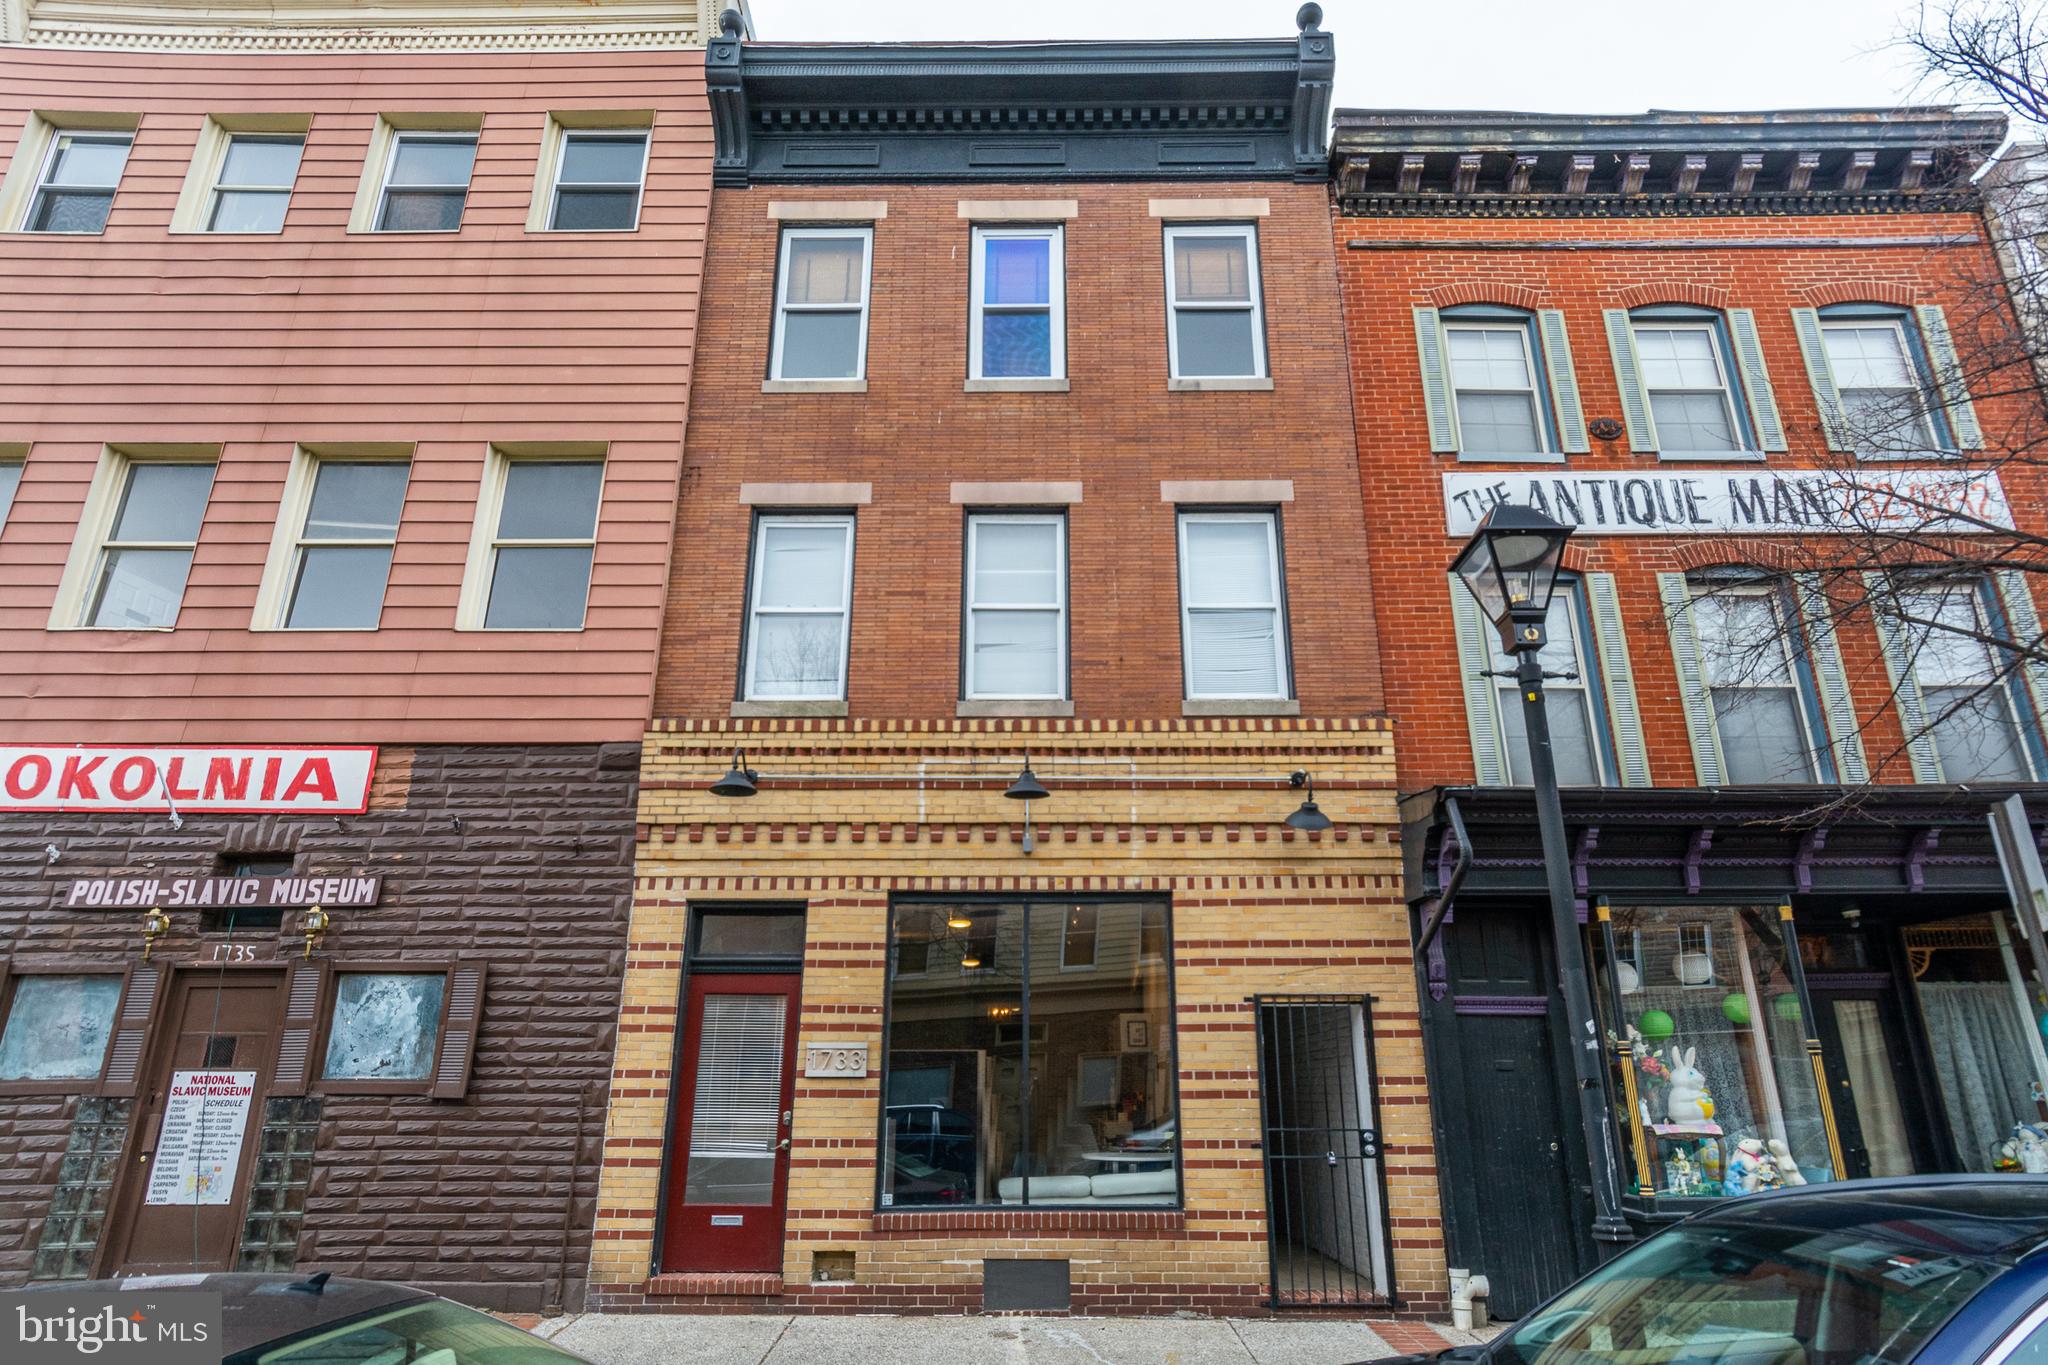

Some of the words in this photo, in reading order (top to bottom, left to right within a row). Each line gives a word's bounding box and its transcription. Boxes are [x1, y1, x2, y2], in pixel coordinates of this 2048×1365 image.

[1452, 480, 1511, 521] THE
[1529, 478, 1713, 528] ANTIQUE
[1728, 478, 1831, 524] MAN
[4, 754, 340, 802] OKOLNIA
[67, 878, 261, 906] POLISH-SLAVIC
[269, 877, 377, 905] MUSEUM
[213, 944, 257, 962] 1735
[809, 1050, 862, 1071] 1733
[190, 1075, 236, 1085] NATIONAL
[172, 1086, 206, 1096] SLAVIC
[207, 1086, 251, 1096] MUSEUM
[205, 1099, 244, 1107] SCHEDULE
